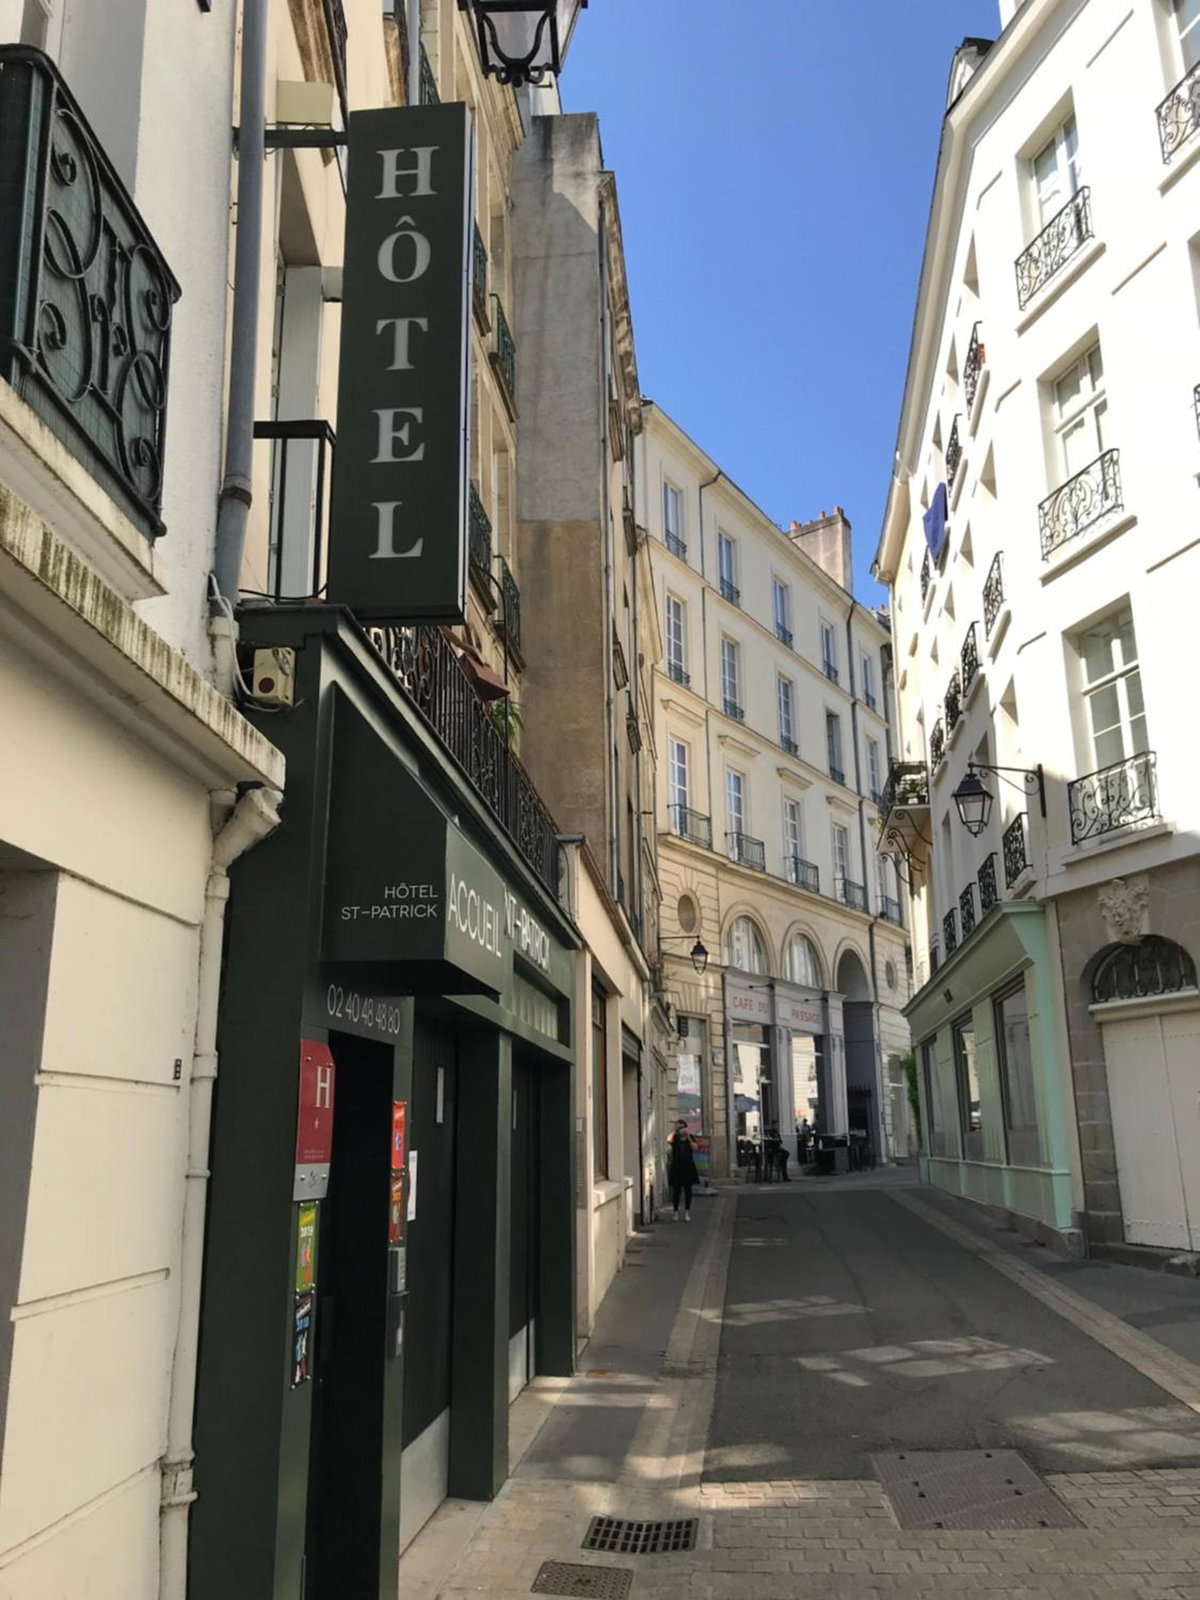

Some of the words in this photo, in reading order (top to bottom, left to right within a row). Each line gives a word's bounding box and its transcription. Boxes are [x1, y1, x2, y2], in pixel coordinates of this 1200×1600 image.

[368, 145, 439, 560] HÔTEL
[340, 903, 438, 921] ST-PATRICK
[384, 882, 439, 899] HÔTEL
[448, 872, 502, 958] ACCUEIL
[327, 984, 344, 1018] 02
[345, 992, 360, 1023] 40
[361, 998, 373, 1027] 48
[375, 1003, 387, 1030] 48
[388, 1006, 400, 1034] 80
[733, 996, 754, 1011] CAFE
[315, 1066, 332, 1109] H
